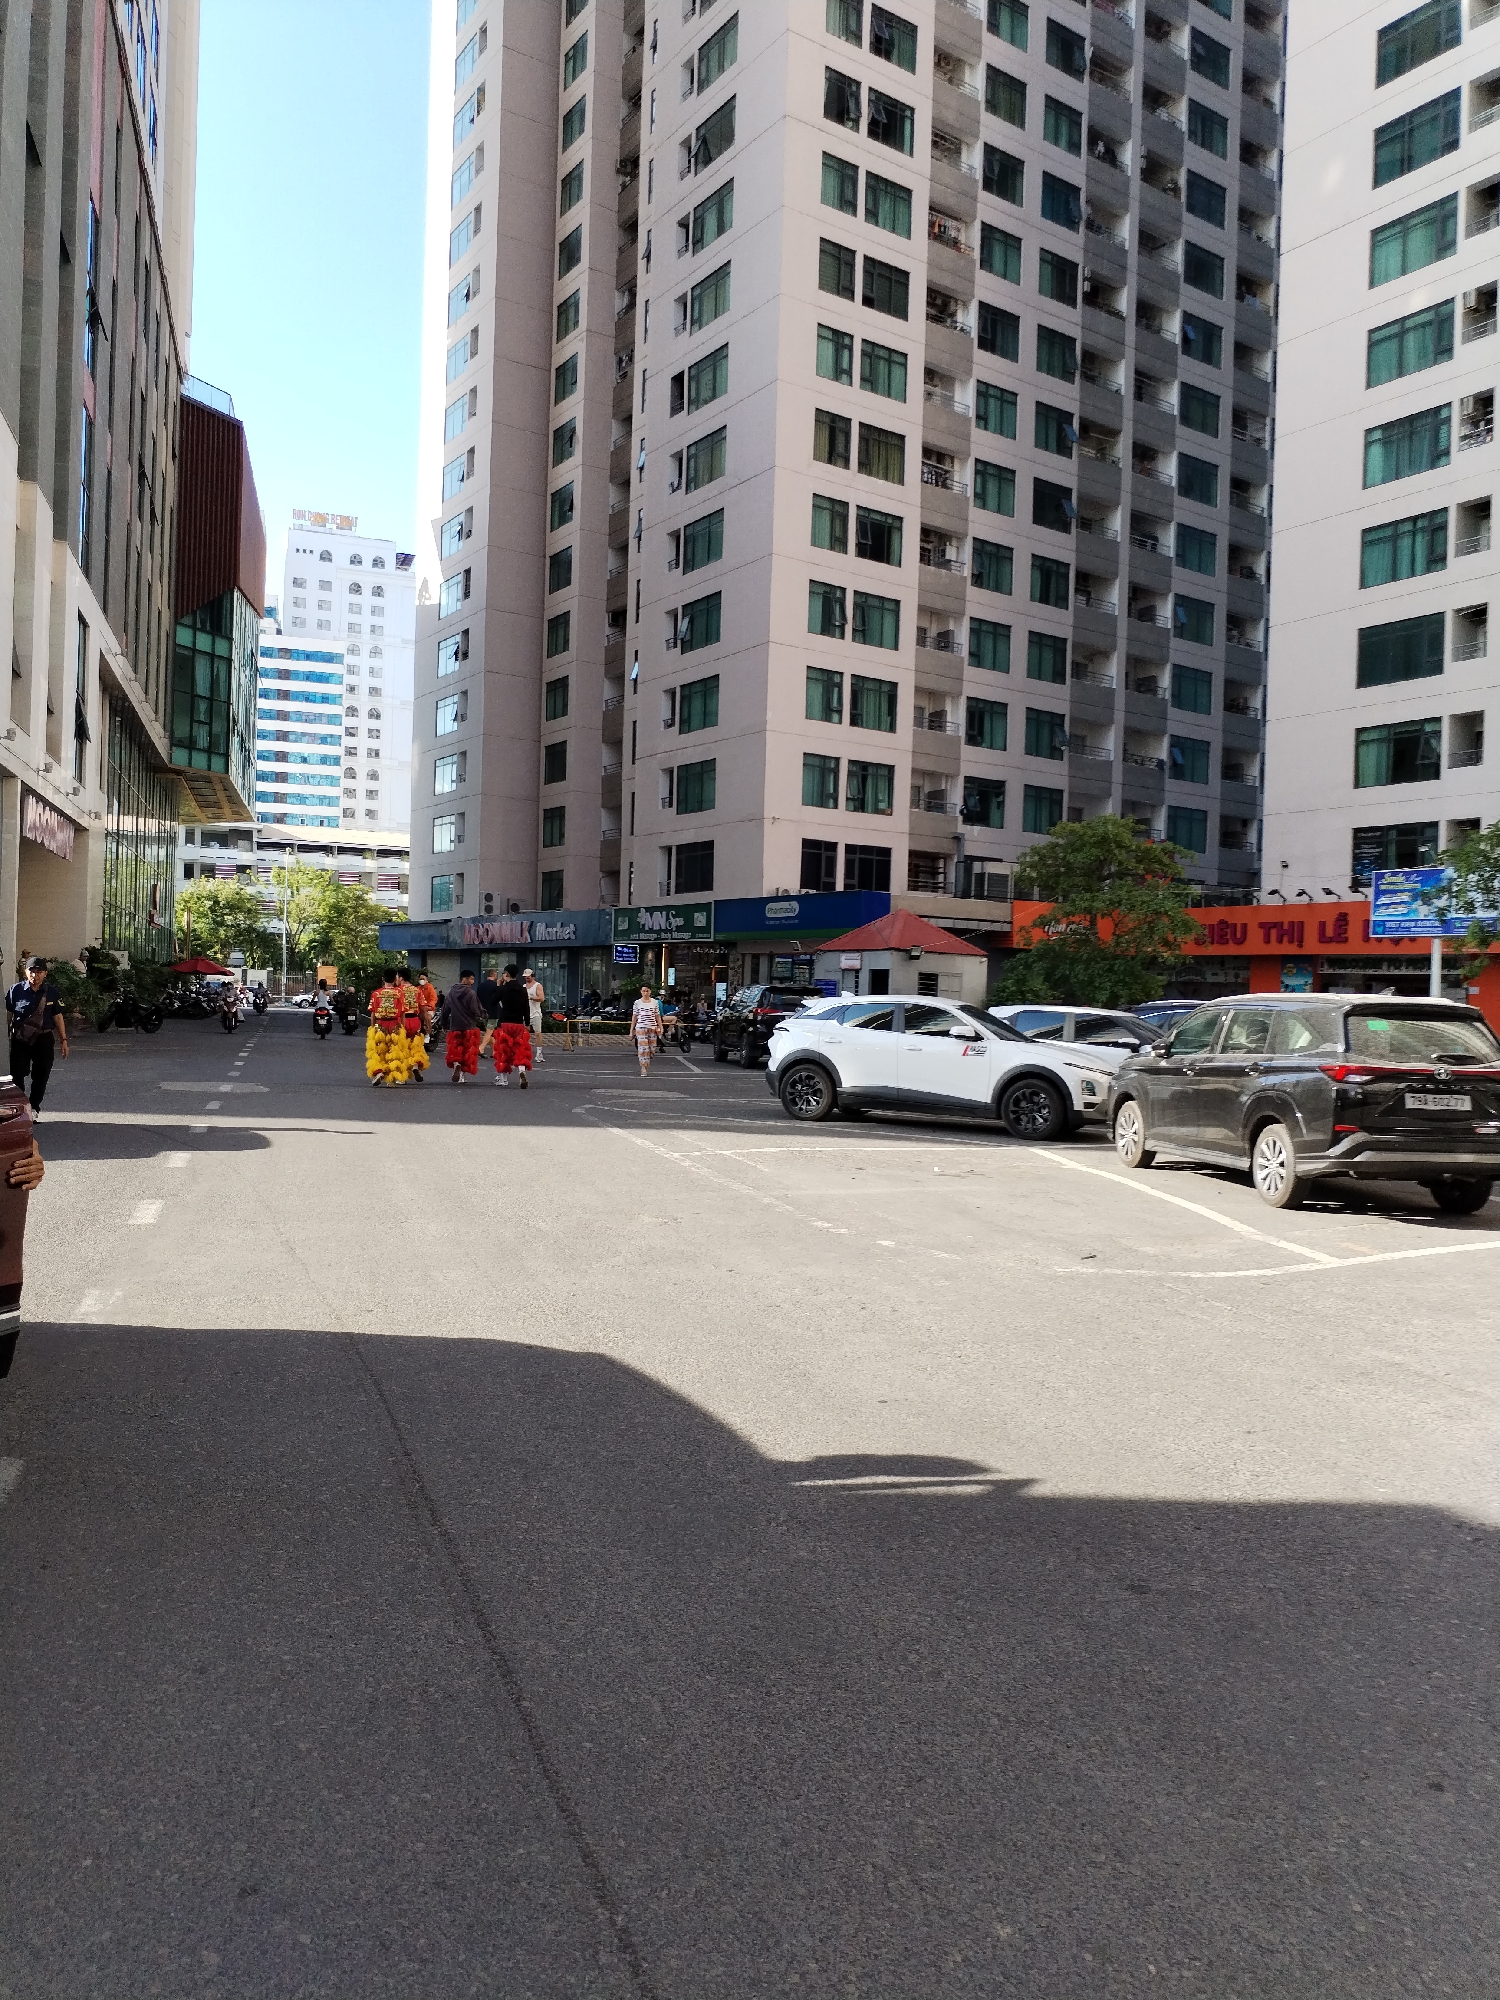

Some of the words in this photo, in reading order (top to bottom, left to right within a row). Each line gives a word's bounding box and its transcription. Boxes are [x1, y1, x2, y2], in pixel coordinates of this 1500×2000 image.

[536, 922, 576, 940] Market
[1258, 920, 1304, 948] THỊ
[1318, 912, 1349, 944] LỄ
